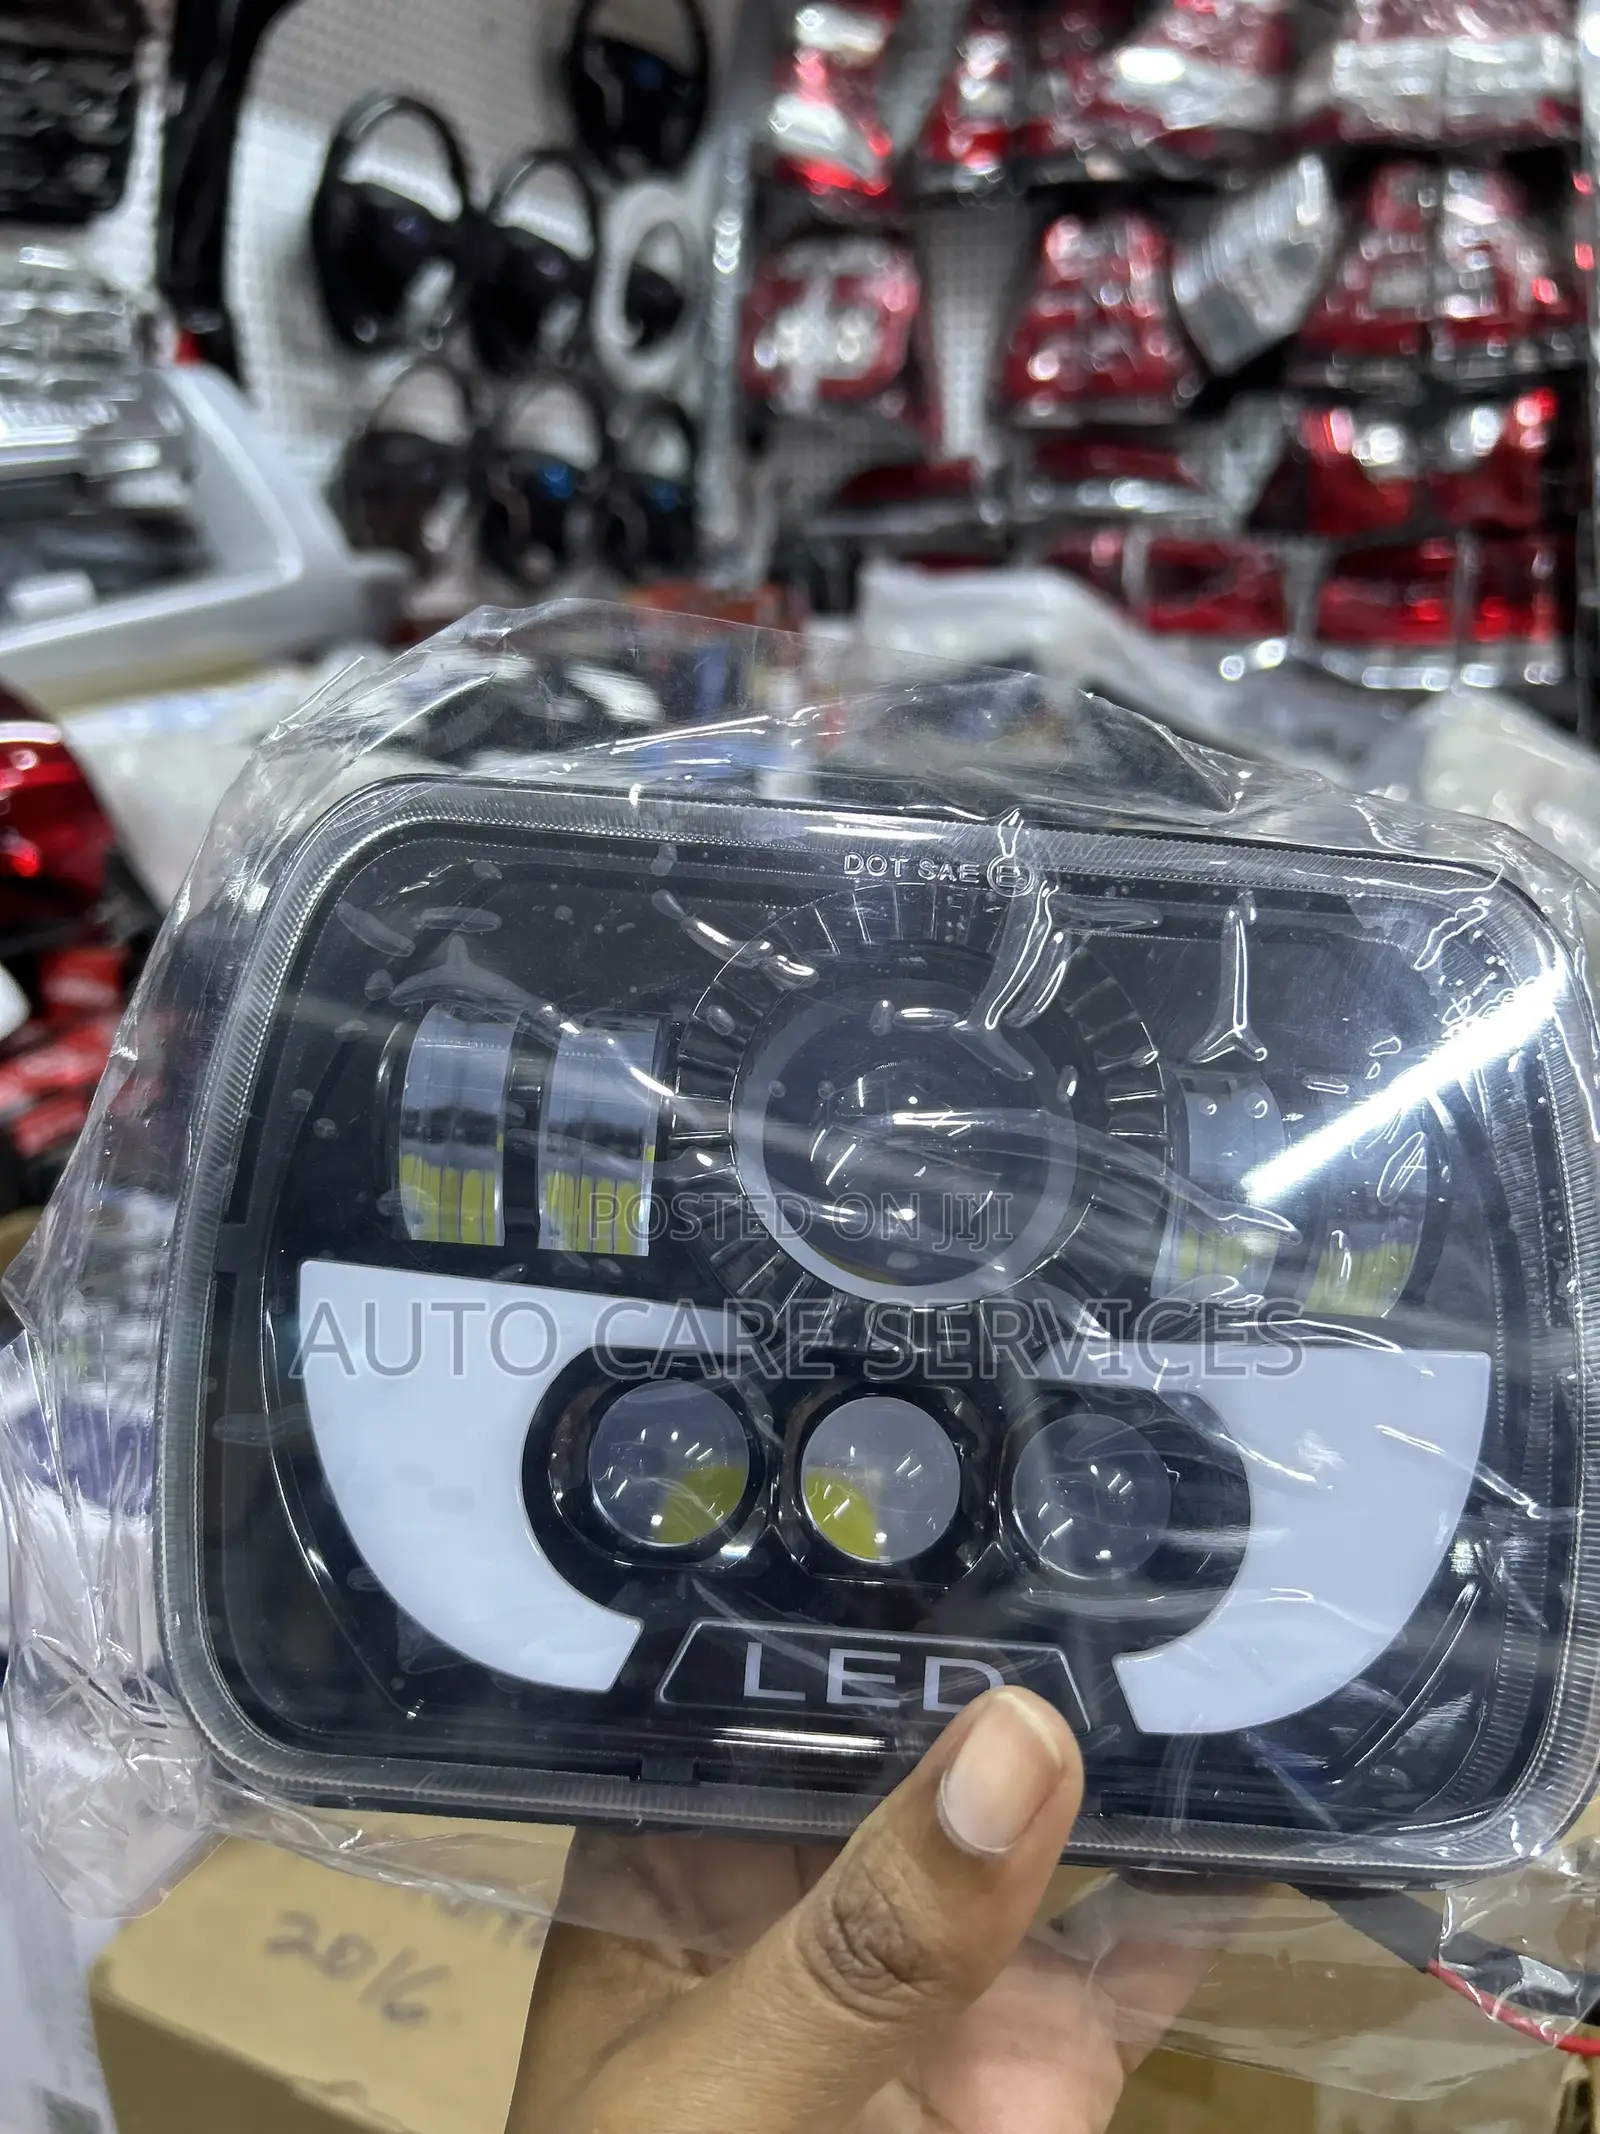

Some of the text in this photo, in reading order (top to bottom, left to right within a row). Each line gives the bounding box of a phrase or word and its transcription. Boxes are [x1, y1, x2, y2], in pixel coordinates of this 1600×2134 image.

[844, 852, 909, 877] DOT
[918, 858, 980, 883] SAE
[743, 1642, 1005, 1714] LED
